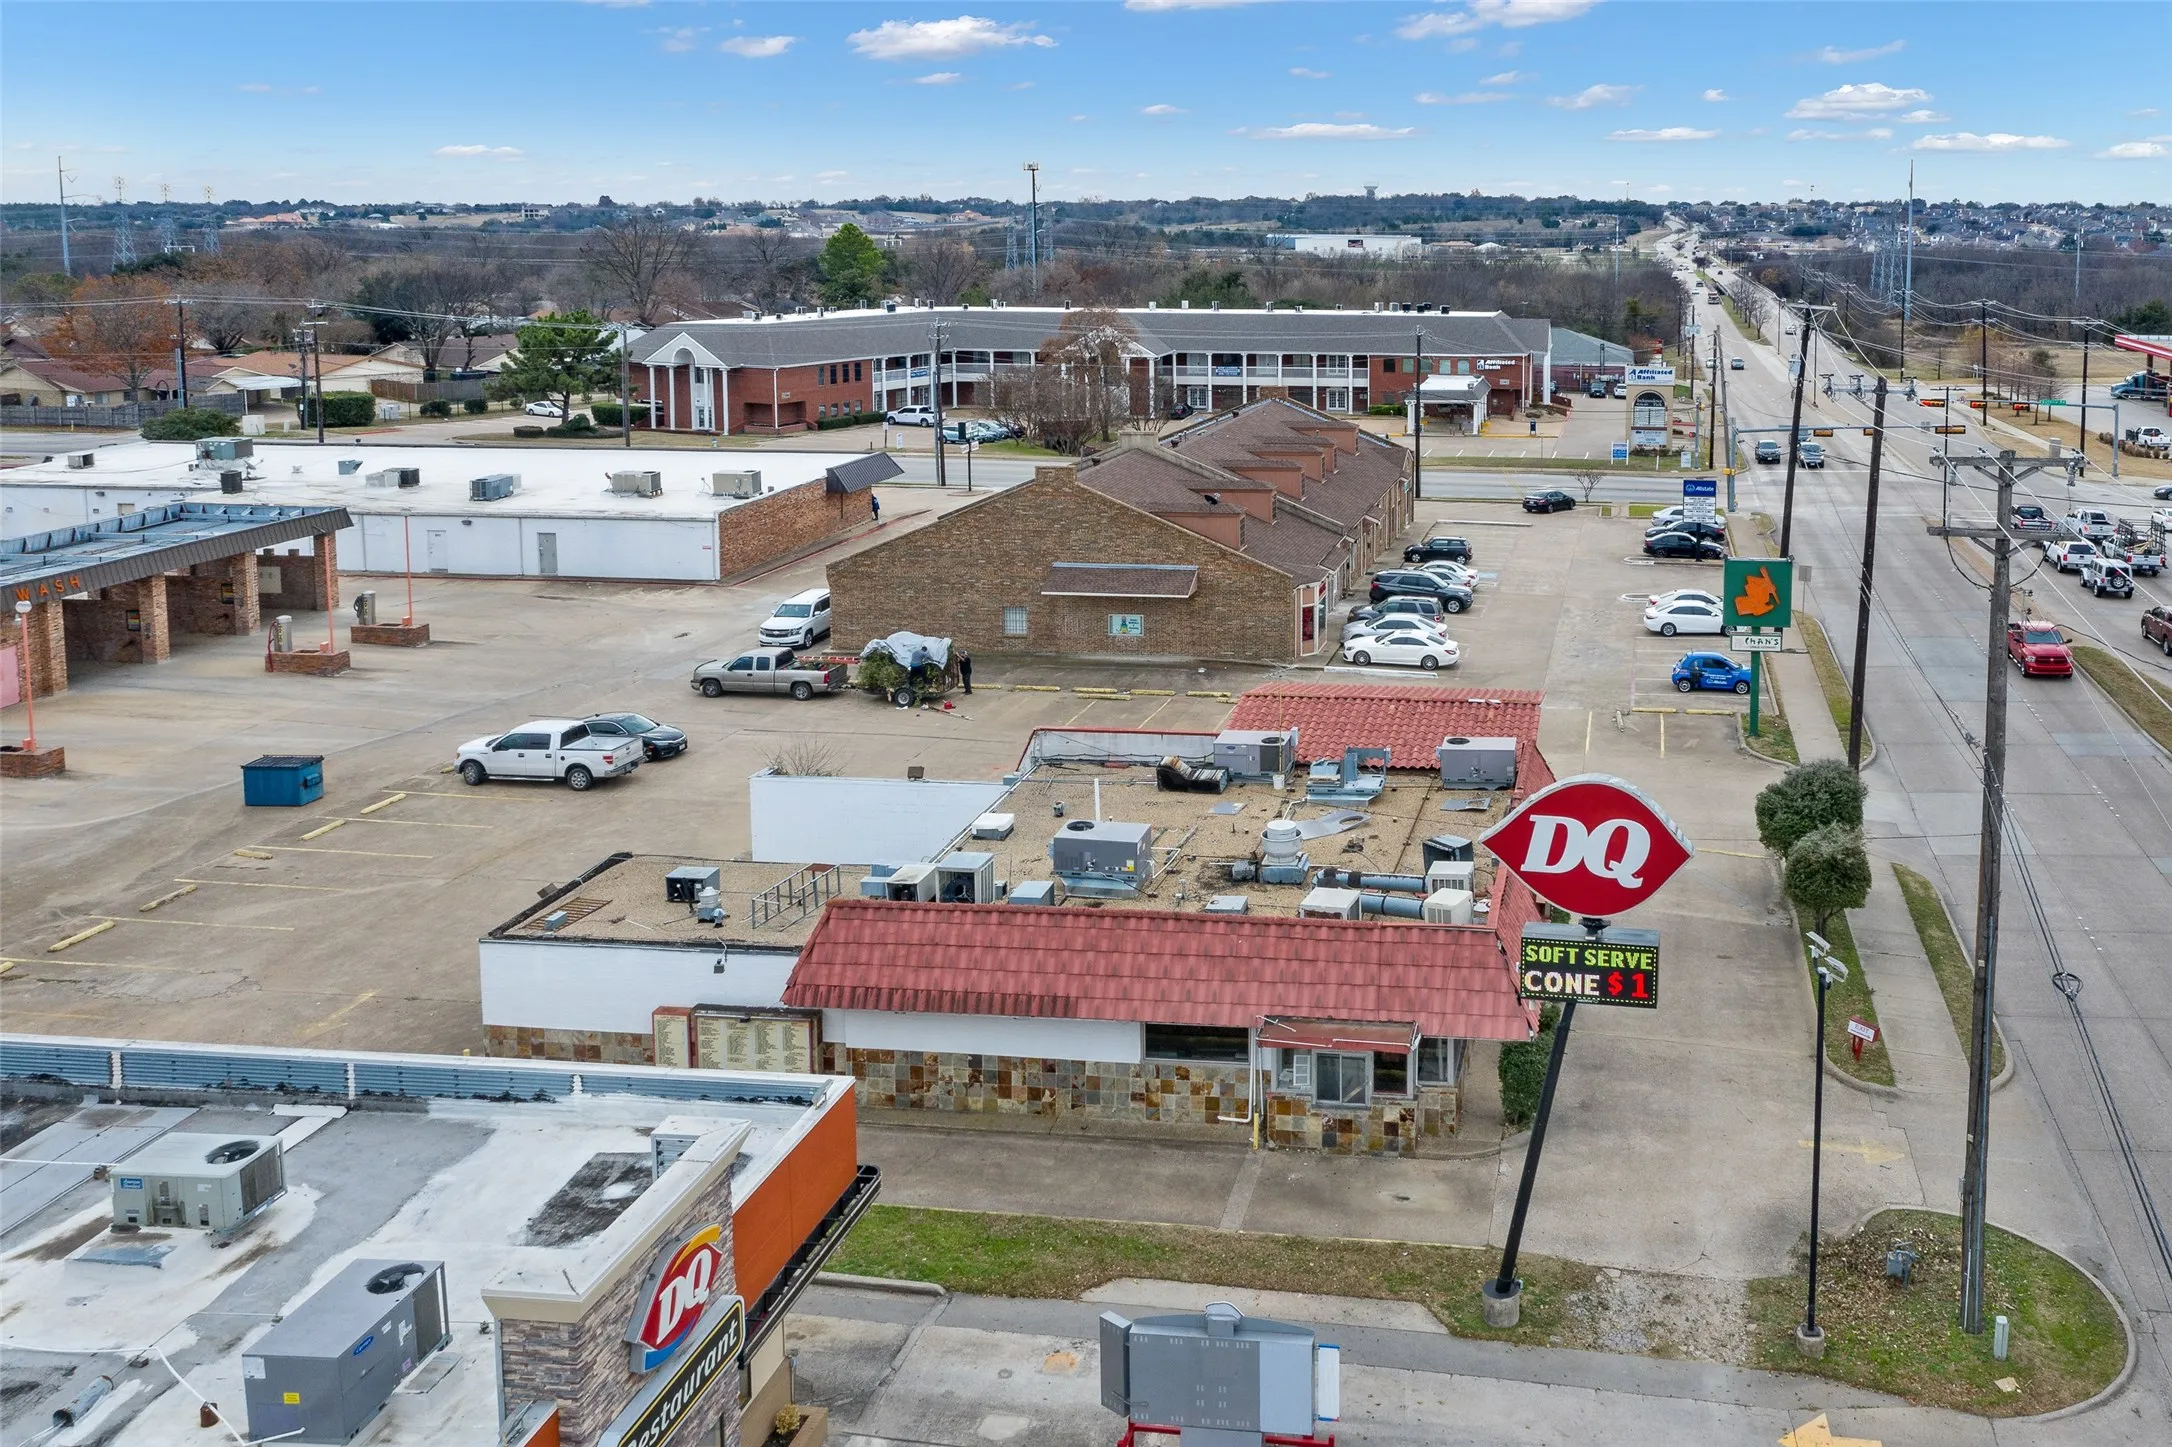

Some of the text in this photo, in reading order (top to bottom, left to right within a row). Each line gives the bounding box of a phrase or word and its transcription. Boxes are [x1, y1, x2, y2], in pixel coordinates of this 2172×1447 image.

[15, 574, 81, 600] WASH
[1520, 814, 1651, 889] DQ
[1525, 945, 1653, 970] SOFT SERVE
[1524, 970, 1600, 996] CONE
[1854, 1023, 1870, 1034] EXIT
[656, 1248, 712, 1345] DQ
